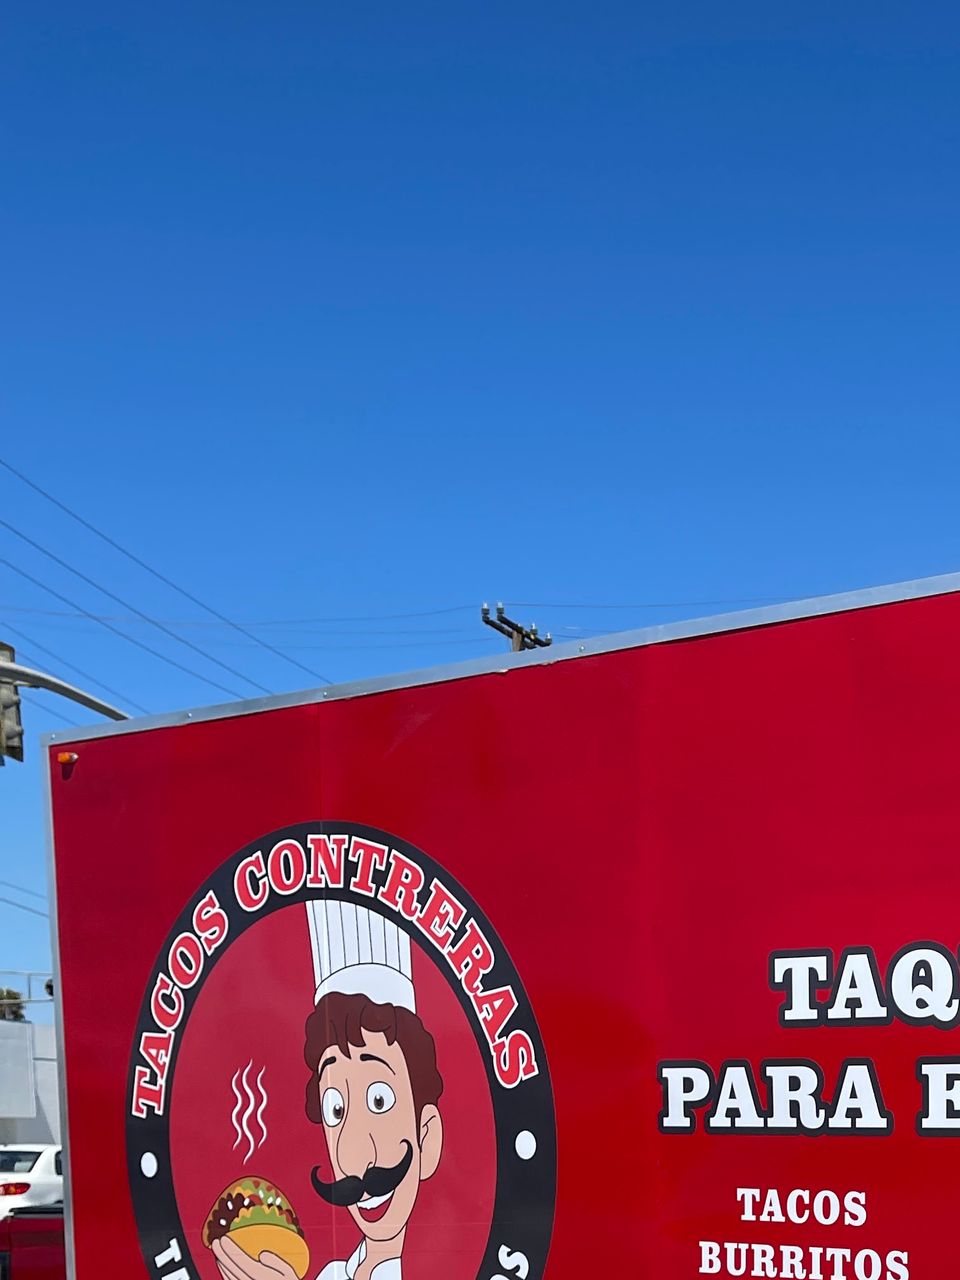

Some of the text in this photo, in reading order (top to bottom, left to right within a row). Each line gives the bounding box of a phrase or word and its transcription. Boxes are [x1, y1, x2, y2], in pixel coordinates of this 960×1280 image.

[131, 834, 540, 1119] TACOS CONTRERAS
[661, 1065, 888, 1129] PARA
[736, 1187, 867, 1227] TACOS
